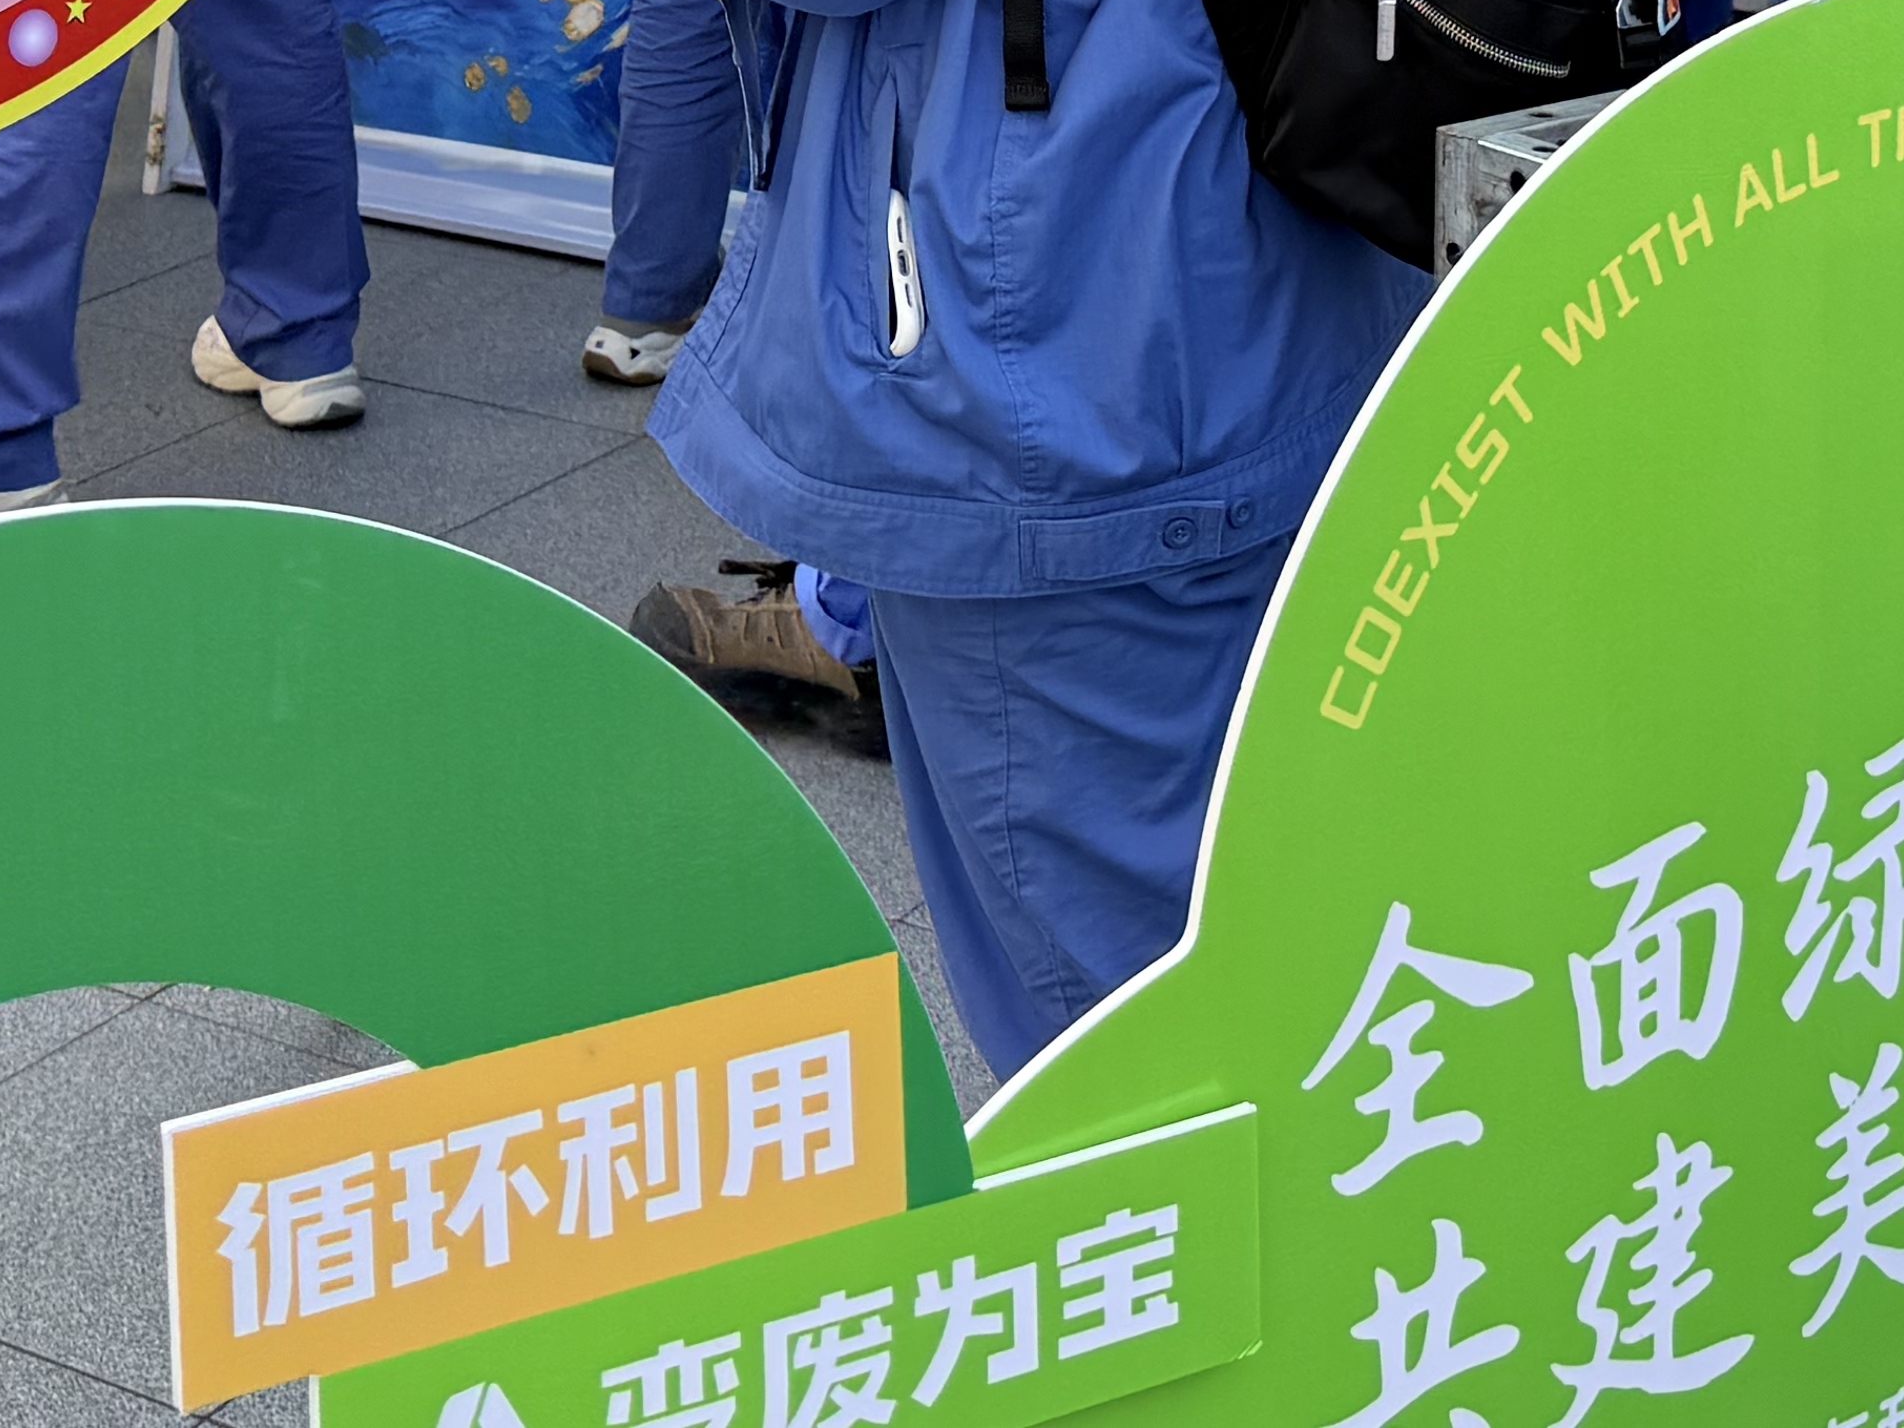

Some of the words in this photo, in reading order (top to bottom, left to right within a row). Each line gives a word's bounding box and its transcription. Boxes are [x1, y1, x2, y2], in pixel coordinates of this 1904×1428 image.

[1319, 365, 1540, 730] COEXIST
[1541, 192, 1716, 370] WITH
[1730, 130, 1841, 231] ALL
[215, 1028, 857, 1340] 循环利用
[601, 1201, 1180, 1428] 变废为宝
